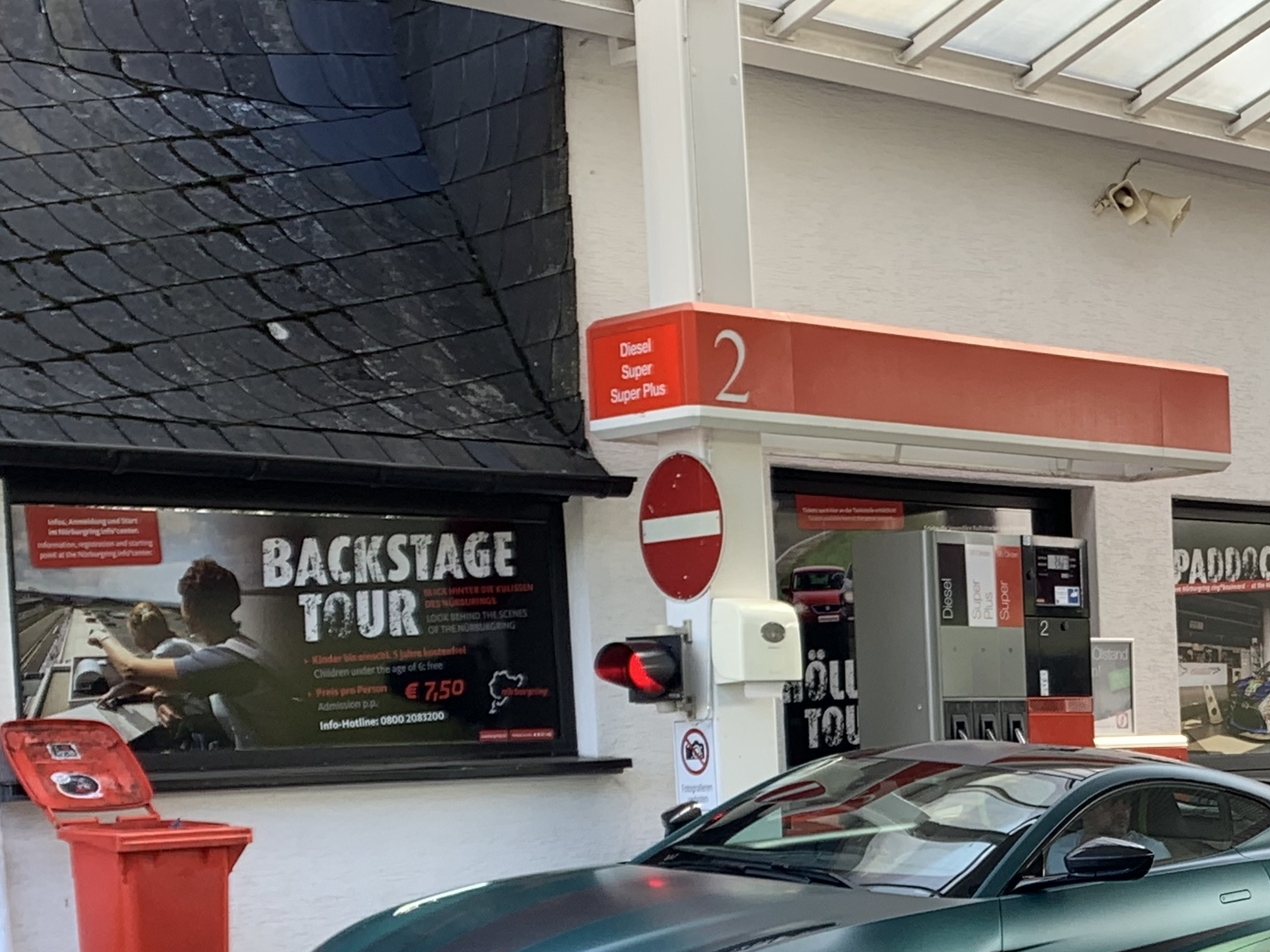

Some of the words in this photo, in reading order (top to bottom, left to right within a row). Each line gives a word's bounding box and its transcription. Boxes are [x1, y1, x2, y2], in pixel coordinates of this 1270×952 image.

[619, 338, 652, 358] Diesel
[621, 363, 653, 381] Super
[714, 329, 750, 403] 2
[610, 387, 641, 404] Super
[643, 382, 667, 398] Plus
[262, 531, 515, 588] BACKSTAGE
[941, 578, 954, 620] Diesel
[972, 580, 982, 620] Super
[984, 592, 993, 620] Plus
[1000, 580, 1010, 620] Super
[298, 588, 420, 642] TOUR
[1040, 620, 1049, 636] 2
[314, 667, 349, 679] Children
[351, 665, 376, 676] under
[377, 663, 390, 674] the
[392, 665, 406, 675] age
[408, 662, 417, 672] of
[426, 662, 444, 670] free
[357, 685, 388, 694] Person
[405, 682, 419, 700] €
[424, 679, 464, 702] 7,50
[318, 700, 360, 712] Admission
[320, 717, 380, 731] Info-Hotline:
[380, 714, 404, 726] 0800
[406, 711, 444, 723] 2083200
